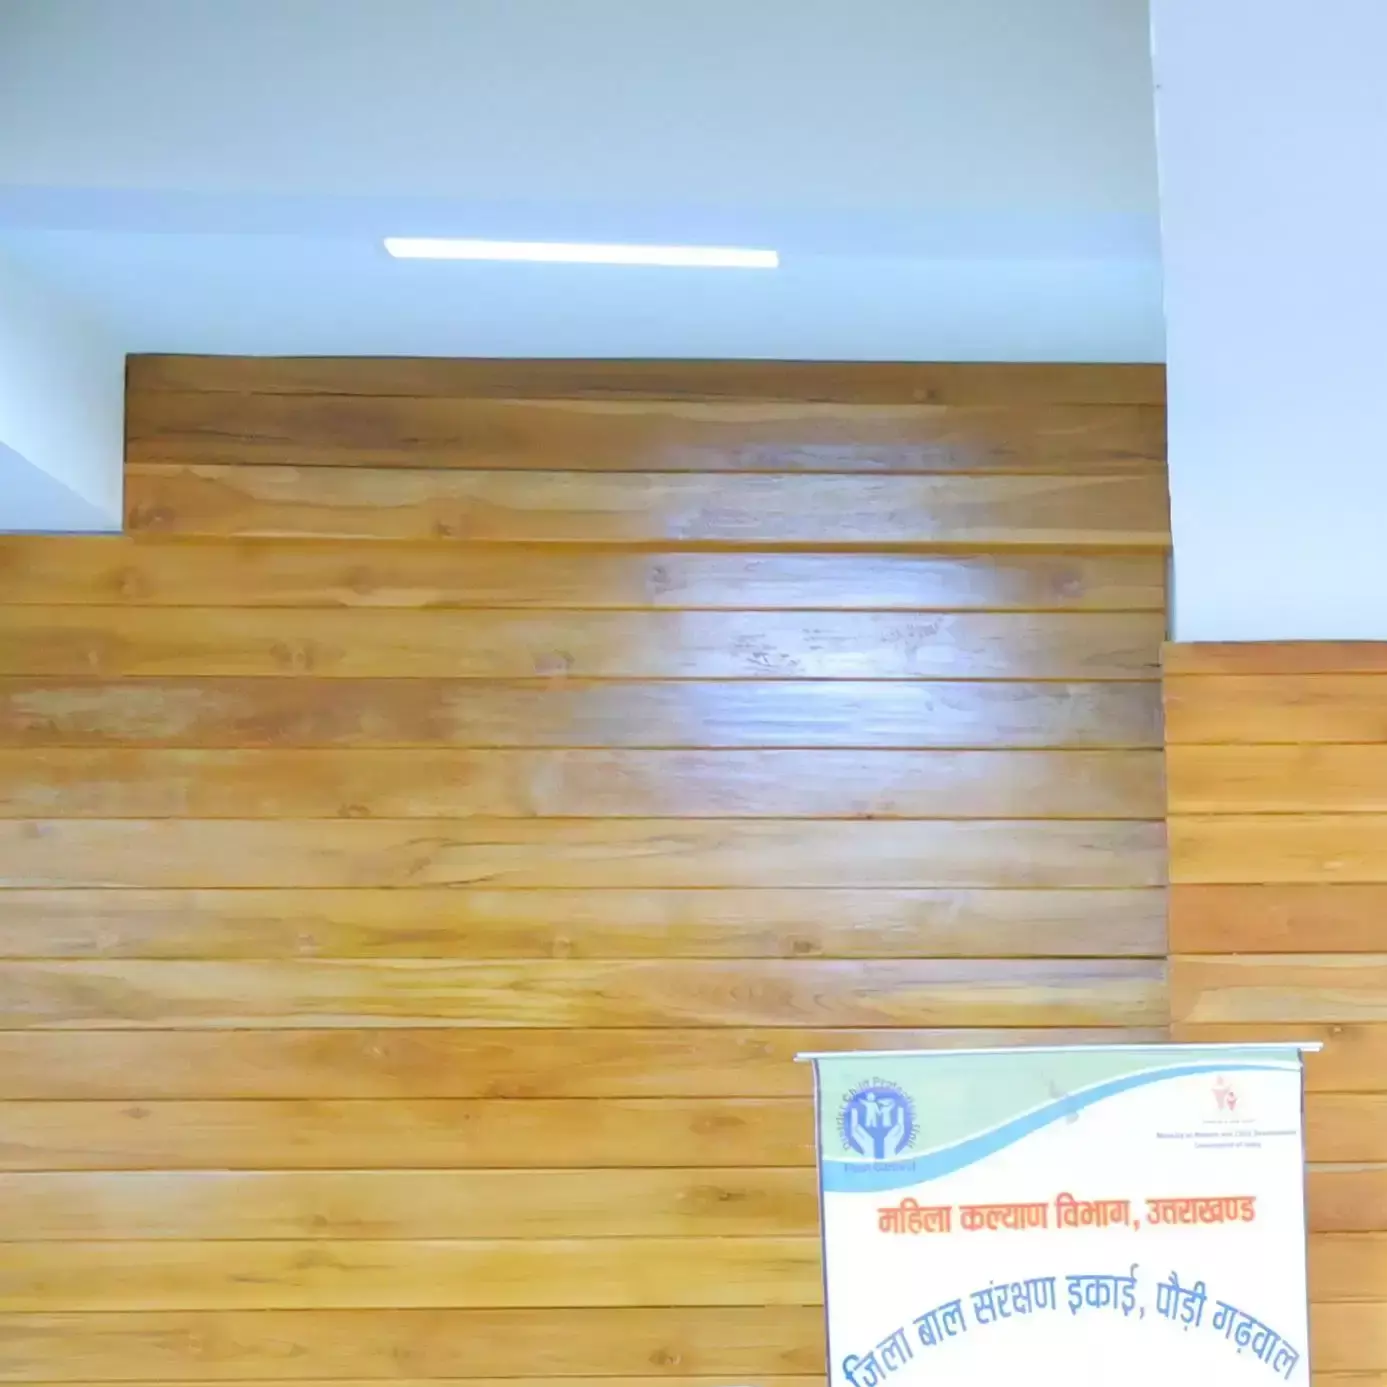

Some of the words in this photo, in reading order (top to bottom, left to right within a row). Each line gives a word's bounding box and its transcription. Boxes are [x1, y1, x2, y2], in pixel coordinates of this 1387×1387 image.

[878, 1197, 952, 1235] महिला
[958, 1201, 1049, 1232] कल्याण
[1055, 1191, 1140, 1232] विभाग,
[1145, 1195, 1257, 1225] उत्तराखण्ड
[916, 1298, 967, 1347] बाल
[970, 1276, 1057, 1325] संरक्षण
[1065, 1263, 1145, 1320] इकाई,
[1156, 1271, 1207, 1332] पौड़ी
[1212, 1300, 1300, 1381] गढ़वाल
